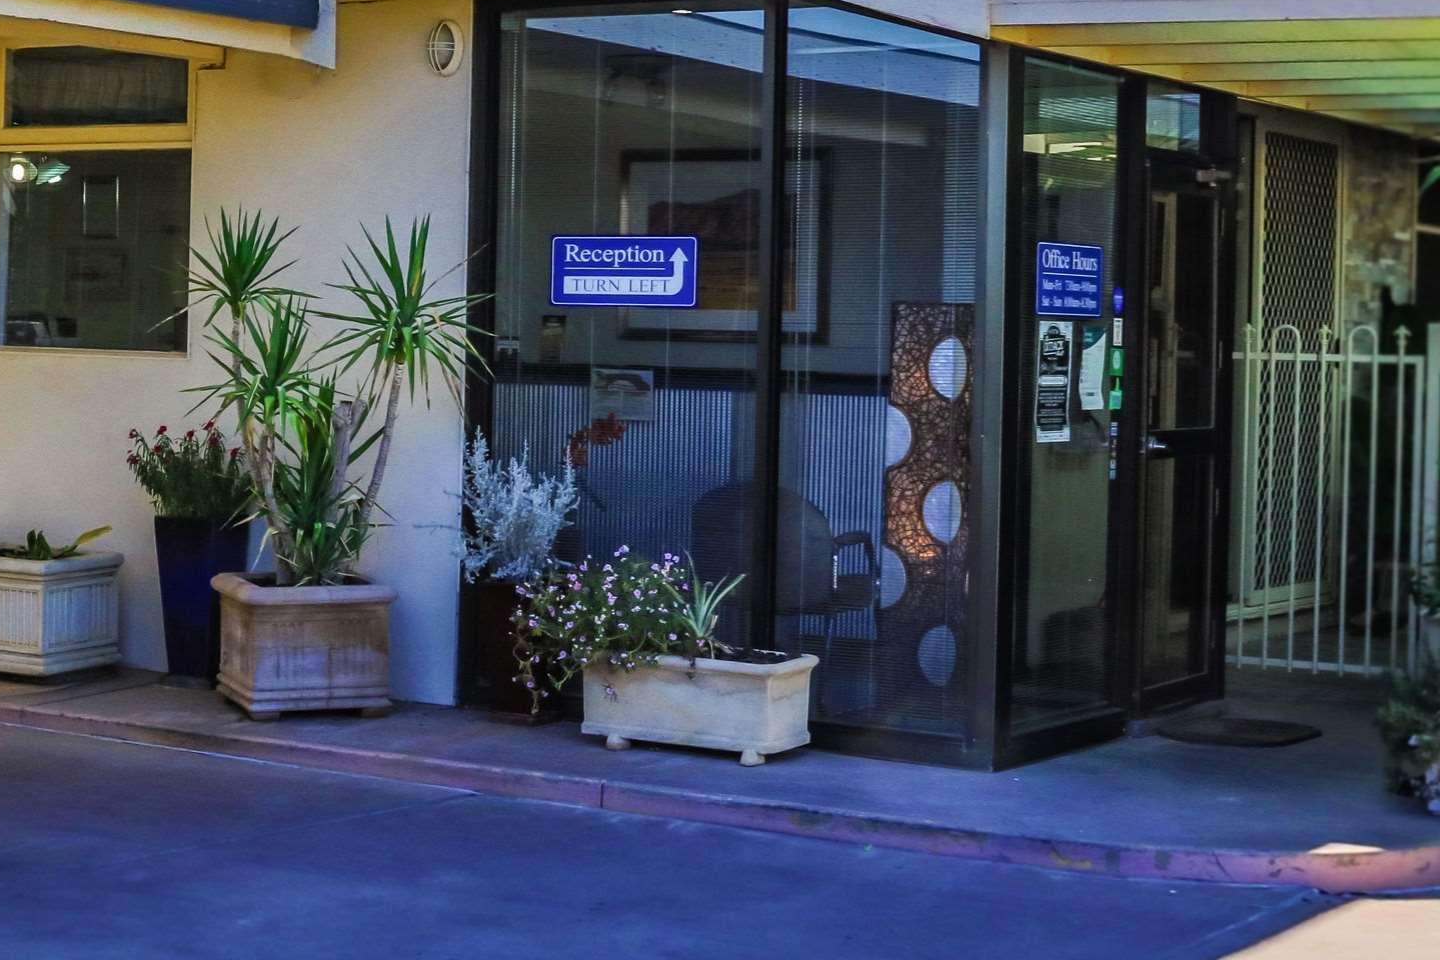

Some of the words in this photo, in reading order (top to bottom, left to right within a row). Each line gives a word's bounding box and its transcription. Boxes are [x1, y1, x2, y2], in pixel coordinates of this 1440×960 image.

[564, 243, 665, 268] Reception
[1042, 248, 1070, 269] Office
[1071, 251, 1098, 271] Hours
[572, 278, 620, 292] TURN
[628, 279, 670, 293] LEFT
